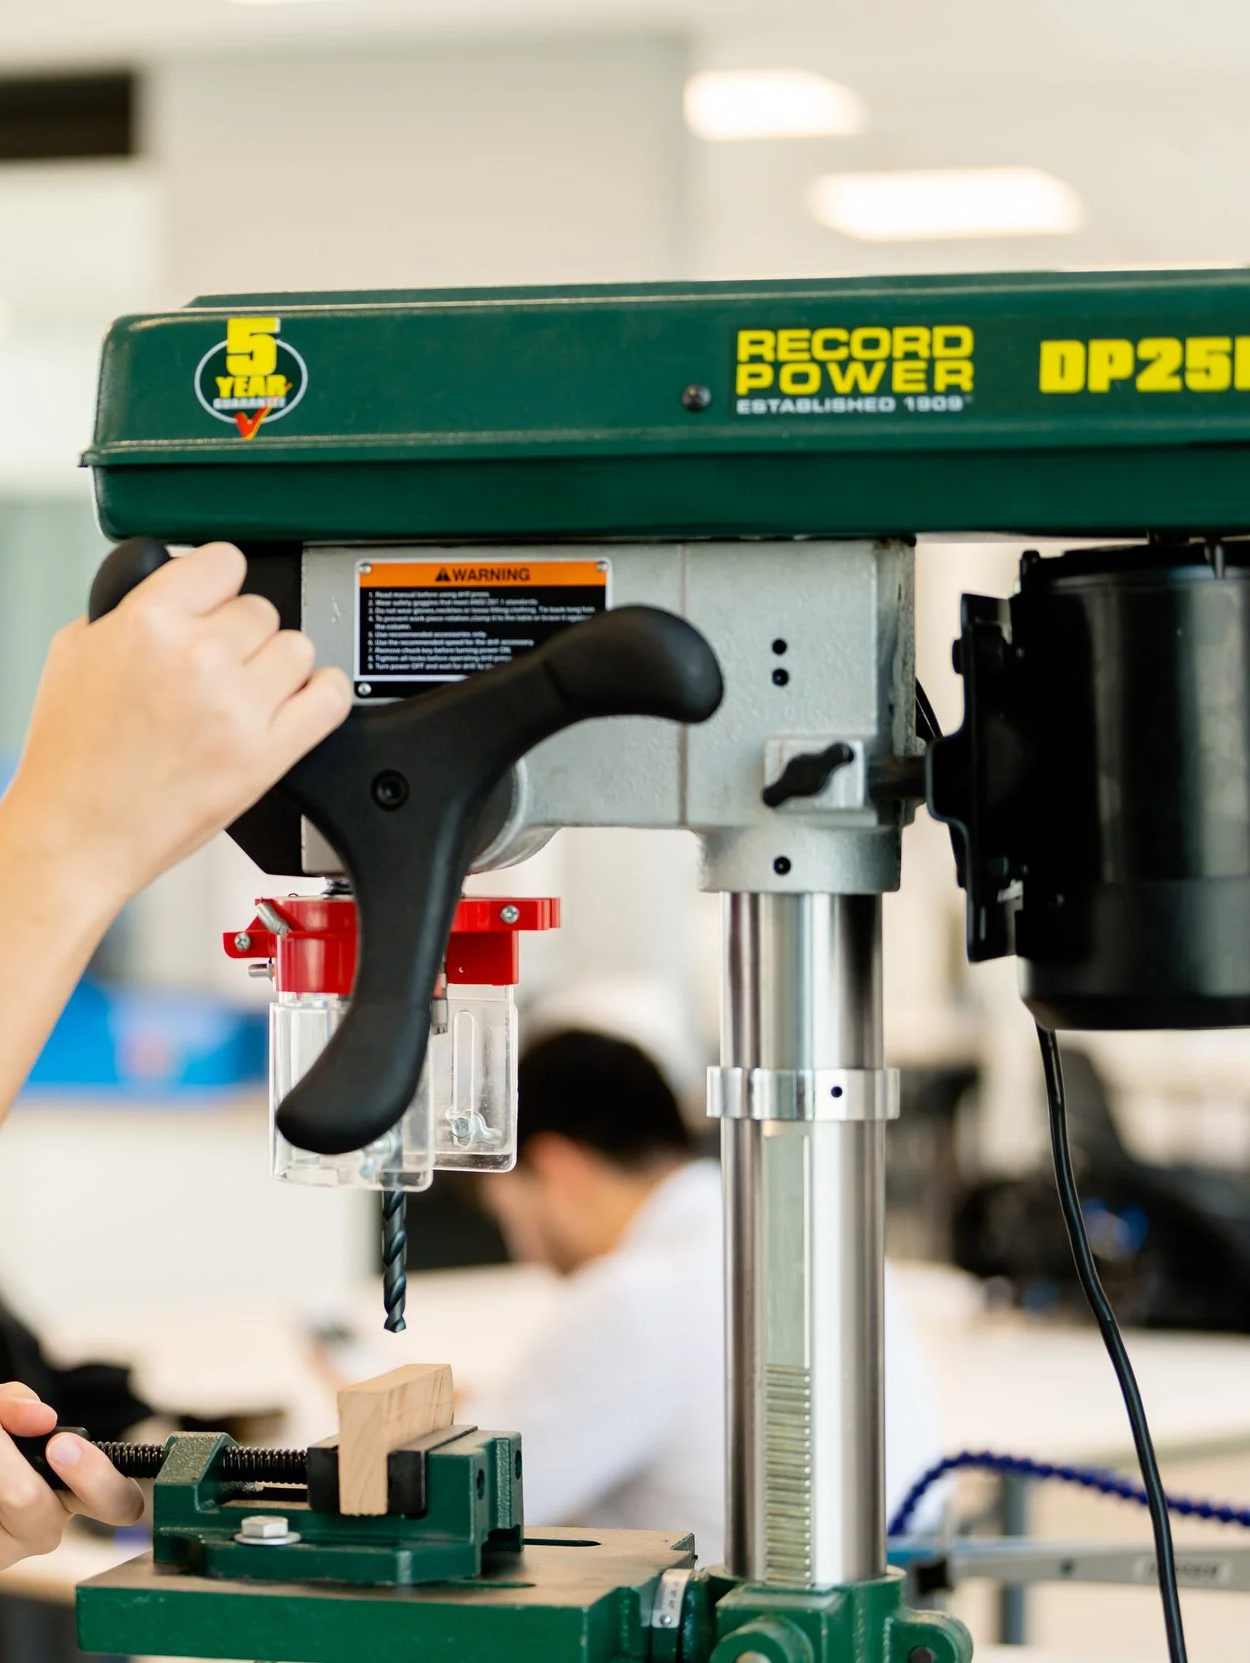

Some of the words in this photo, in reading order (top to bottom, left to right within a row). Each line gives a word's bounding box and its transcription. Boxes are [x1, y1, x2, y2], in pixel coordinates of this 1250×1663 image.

[226, 316, 281, 376] 5
[737, 325, 974, 363] RECORD
[215, 373, 287, 399] YEAR
[735, 359, 974, 396] POWER
[736, 397, 896, 415] ESTABLISHED
[453, 568, 530, 582] WARNING
